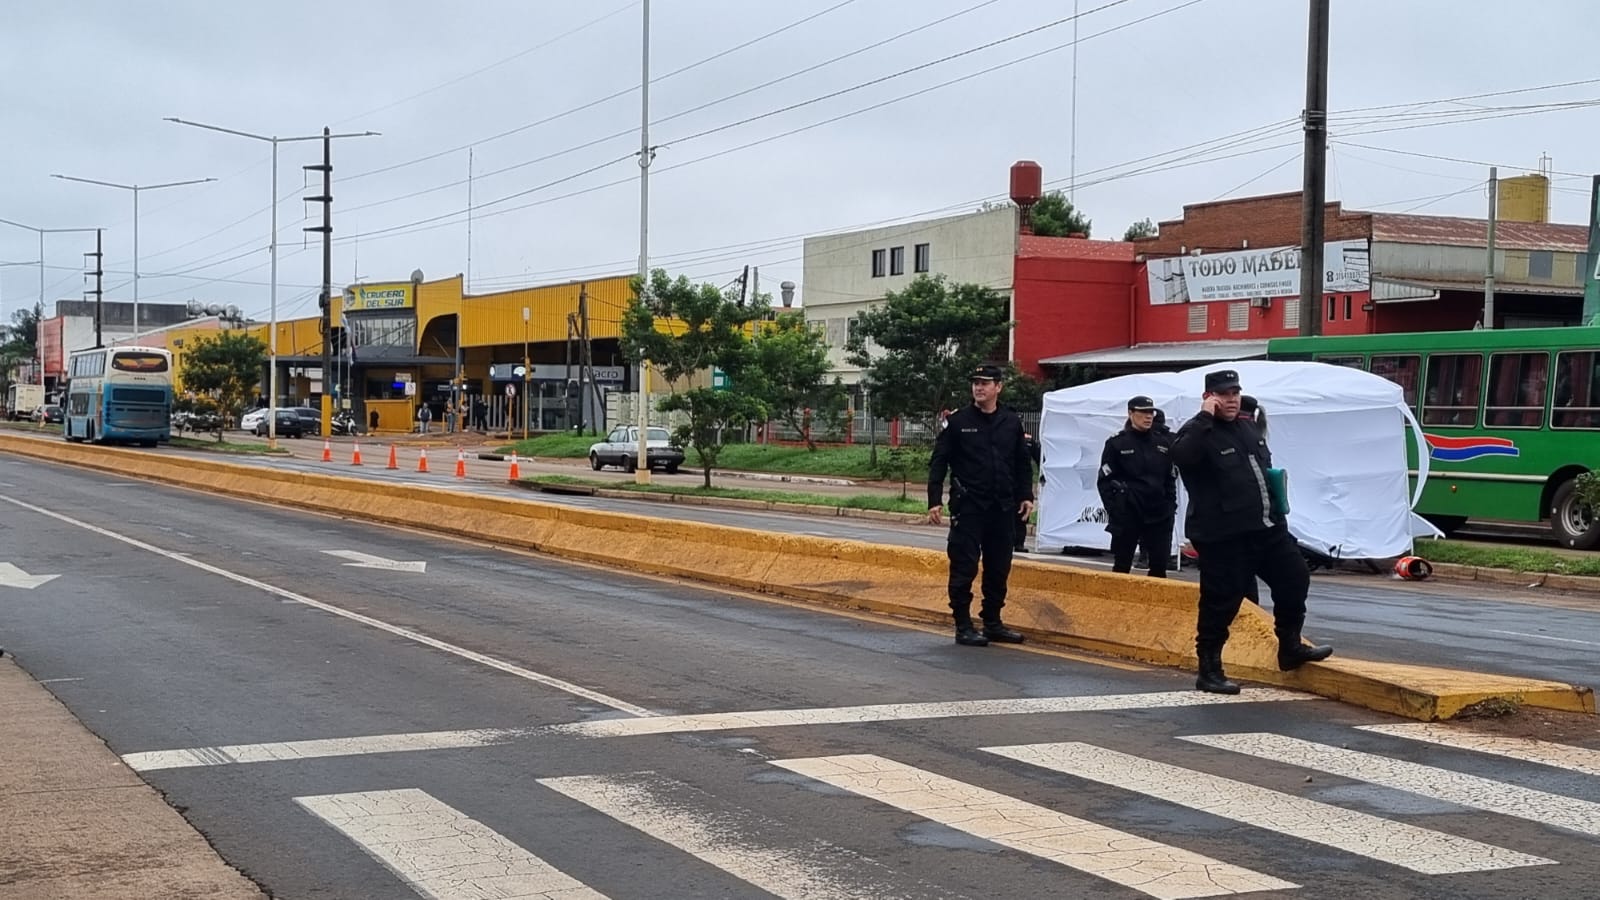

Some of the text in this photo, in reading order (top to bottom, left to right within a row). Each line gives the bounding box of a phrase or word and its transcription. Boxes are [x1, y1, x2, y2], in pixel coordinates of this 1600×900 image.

[1189, 257, 1237, 277] TODO
[367, 290, 405, 299] CRUCERO
[367, 299, 405, 308] DEL SUR
